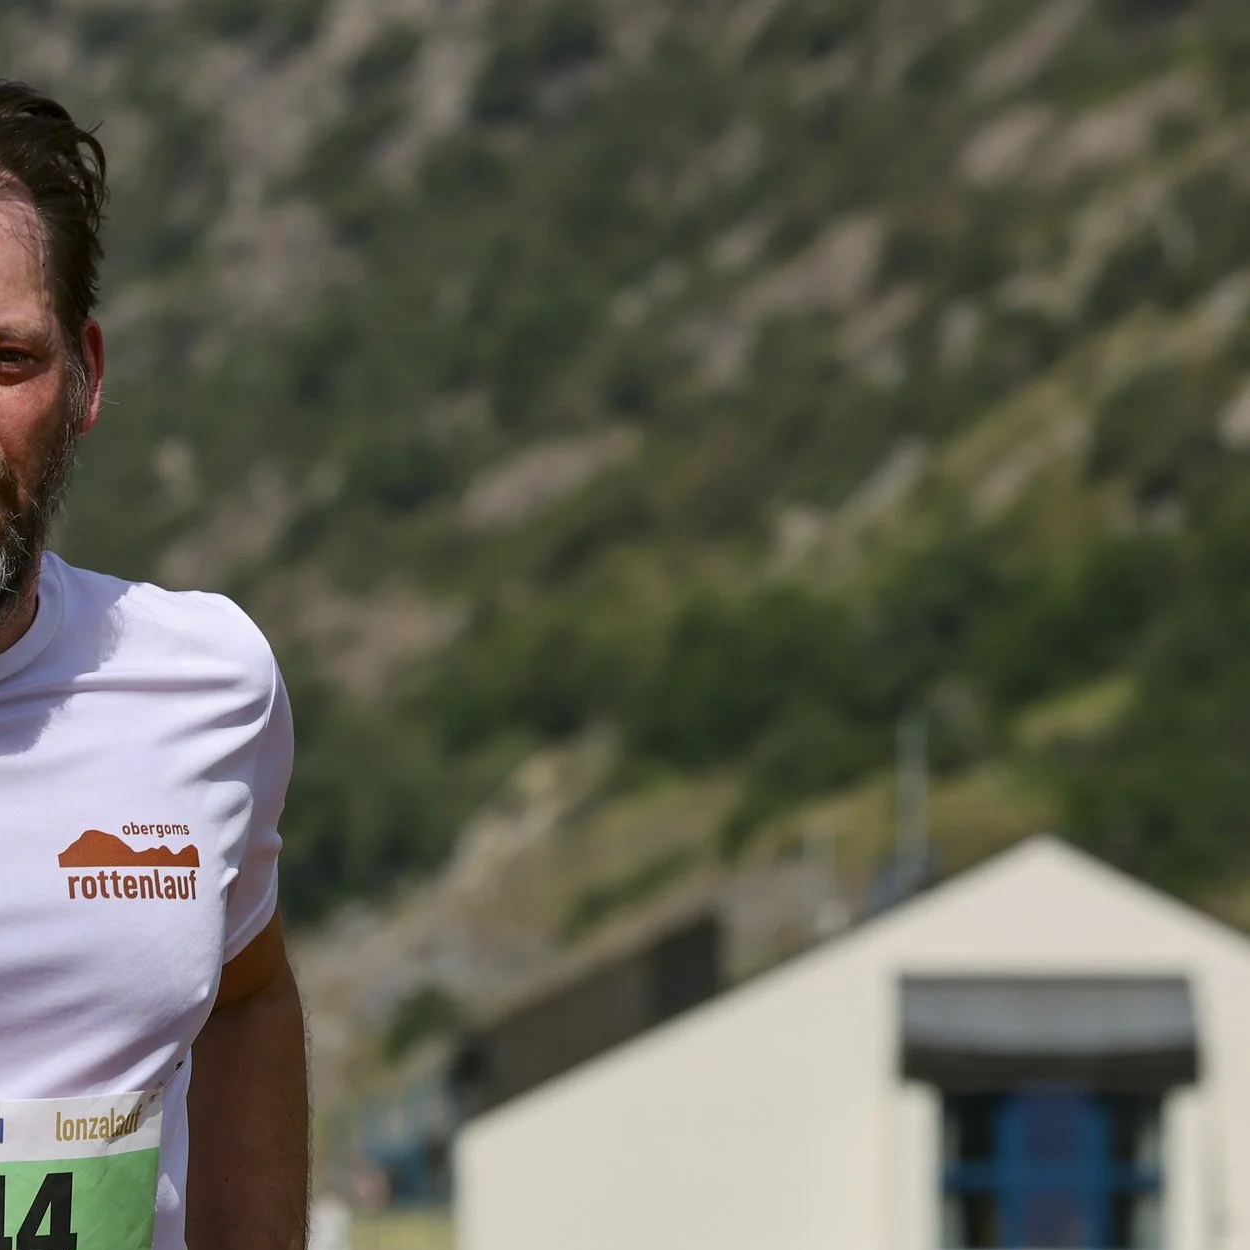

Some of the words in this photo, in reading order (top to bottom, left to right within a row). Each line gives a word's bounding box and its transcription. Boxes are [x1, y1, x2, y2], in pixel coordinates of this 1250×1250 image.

[122, 822, 190, 838] obergoms
[68, 869, 196, 900] rottenlauf
[55, 1103, 143, 1142] lonzalauf
